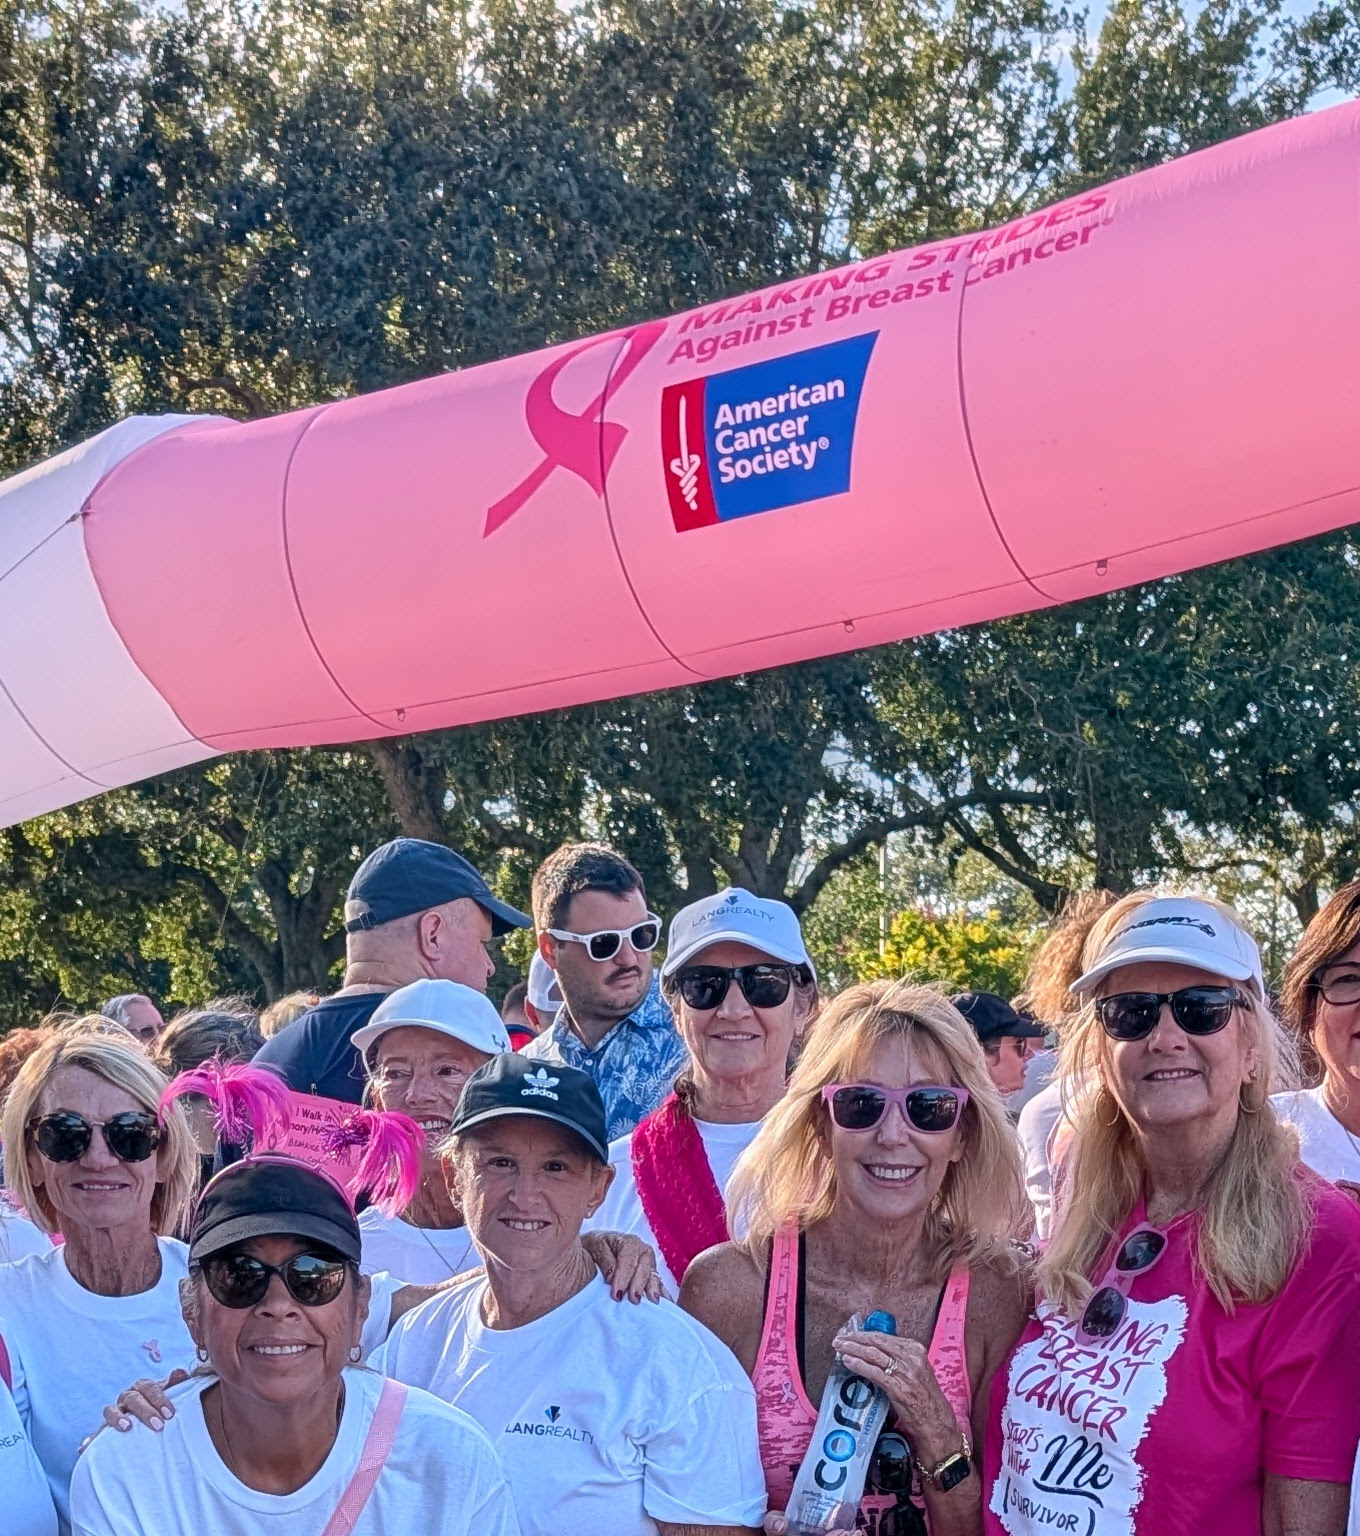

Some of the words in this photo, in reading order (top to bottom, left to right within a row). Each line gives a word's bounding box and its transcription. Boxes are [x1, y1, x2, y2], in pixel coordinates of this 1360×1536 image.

[678, 259, 892, 335] MAKING
[907, 190, 1110, 272] STRIDES
[666, 307, 816, 366] Against
[824, 269, 955, 322] Breast
[714, 378, 845, 430] American
[715, 414, 810, 455] Cancer
[691, 906, 775, 929] LANGREALTY
[520, 1086, 559, 1101] adidas
[302, 1108, 323, 1123] Walk
[1014, 1363, 1128, 1444] CANCER
[504, 1422, 594, 1445] LANGREALTY
[814, 1375, 876, 1492] core
[1005, 1417, 1045, 1453] STARTS
[1007, 1443, 1032, 1476] WITH
[1044, 1434, 1114, 1490] Me
